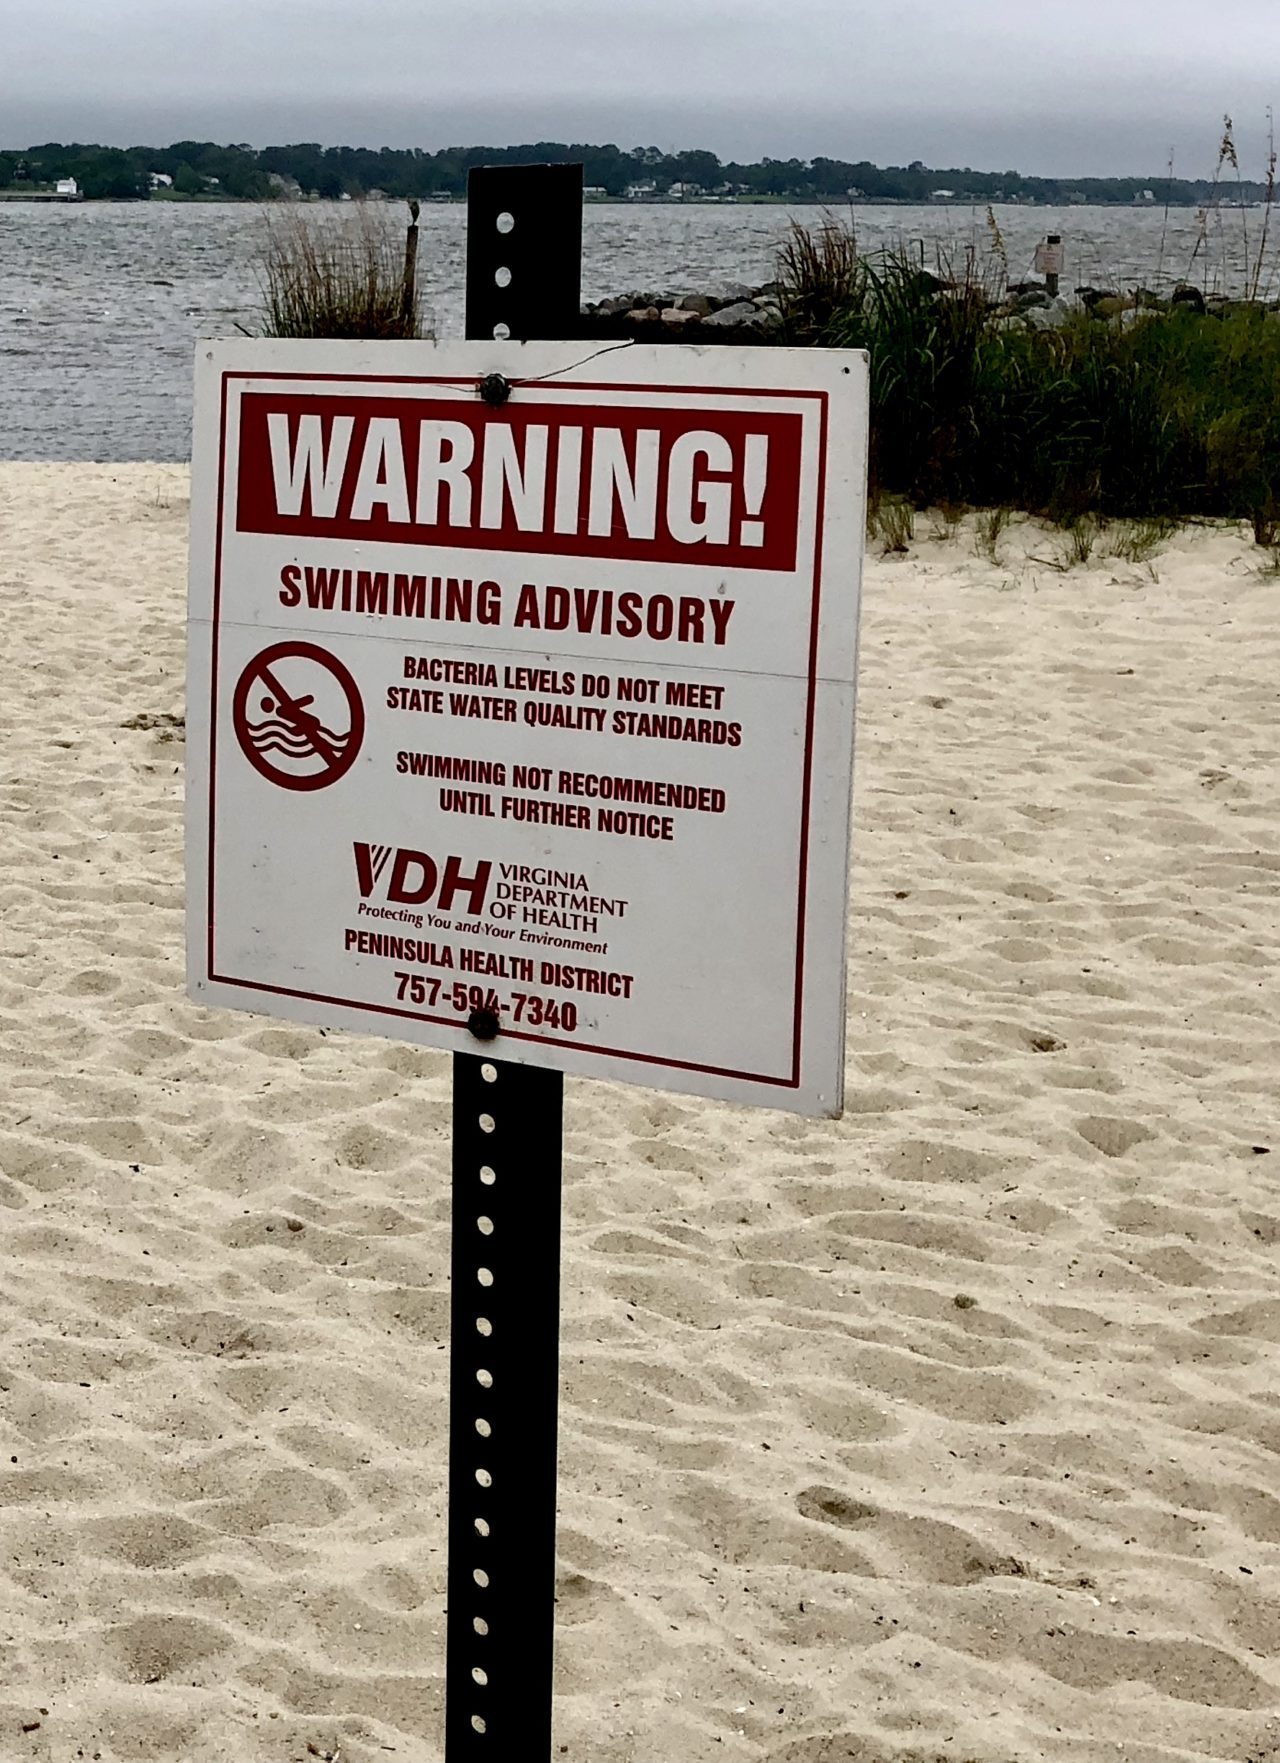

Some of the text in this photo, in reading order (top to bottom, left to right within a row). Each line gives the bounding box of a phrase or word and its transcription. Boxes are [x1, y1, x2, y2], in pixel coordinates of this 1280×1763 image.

[266, 412, 770, 549] WARNING!
[279, 564, 736, 647] SWIMMING ADVISORY
[403, 655, 726, 712] BACTERIA LEVELS DO NOT MEET
[386, 686, 743, 748] STATE WATER QUALITY STANDARDS
[396, 750, 728, 814] SWIMMING NOT RECOMMENDED
[439, 787, 674, 841] UNTIL FURTHER NOTICE
[352, 841, 493, 917] VDH
[496, 882, 629, 918] DEPARTMENT
[498, 862, 590, 892] VIRGINIA
[357, 902, 608, 955] Protecting You and Your Environment
[489, 901, 599, 934] OF HEALTH
[344, 928, 635, 999] PENINSULA HEALTH DISTRICT
[394, 971, 579, 1033] 757-594-7340
